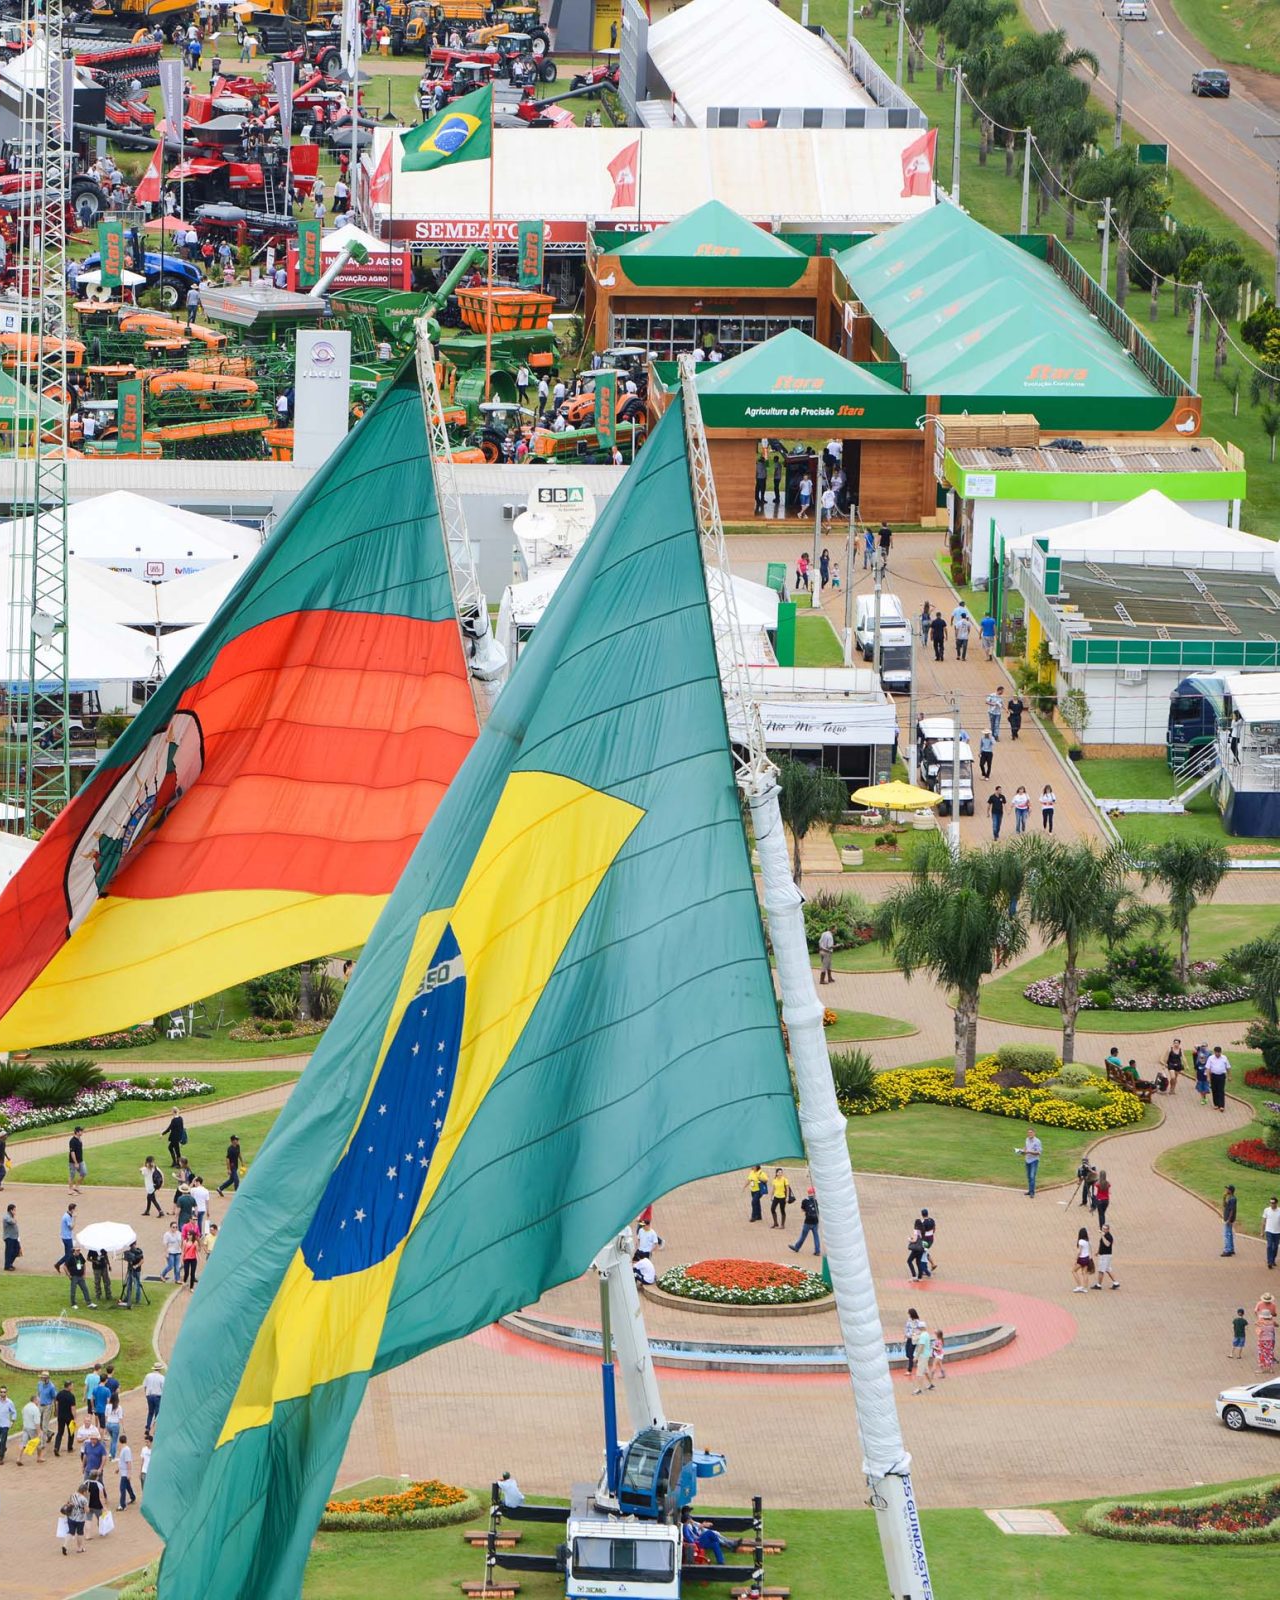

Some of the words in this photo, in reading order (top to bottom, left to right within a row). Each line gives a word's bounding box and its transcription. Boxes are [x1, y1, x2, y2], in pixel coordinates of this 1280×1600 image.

[105, 233, 119, 277] Stara
[303, 230, 317, 276] Stara
[376, 257, 403, 266] AGRO
[522, 231, 539, 277] Stara
[774, 375, 825, 389] Stara
[1025, 364, 1089, 381] Stara
[122, 394, 137, 442] Stara
[598, 386, 611, 437] Stara
[745, 406, 787, 417] Agricultura
[789, 407, 800, 416] de
[801, 407, 835, 416] Precisão
[837, 405, 865, 416] Stara
[538, 488, 584, 502] SBA
